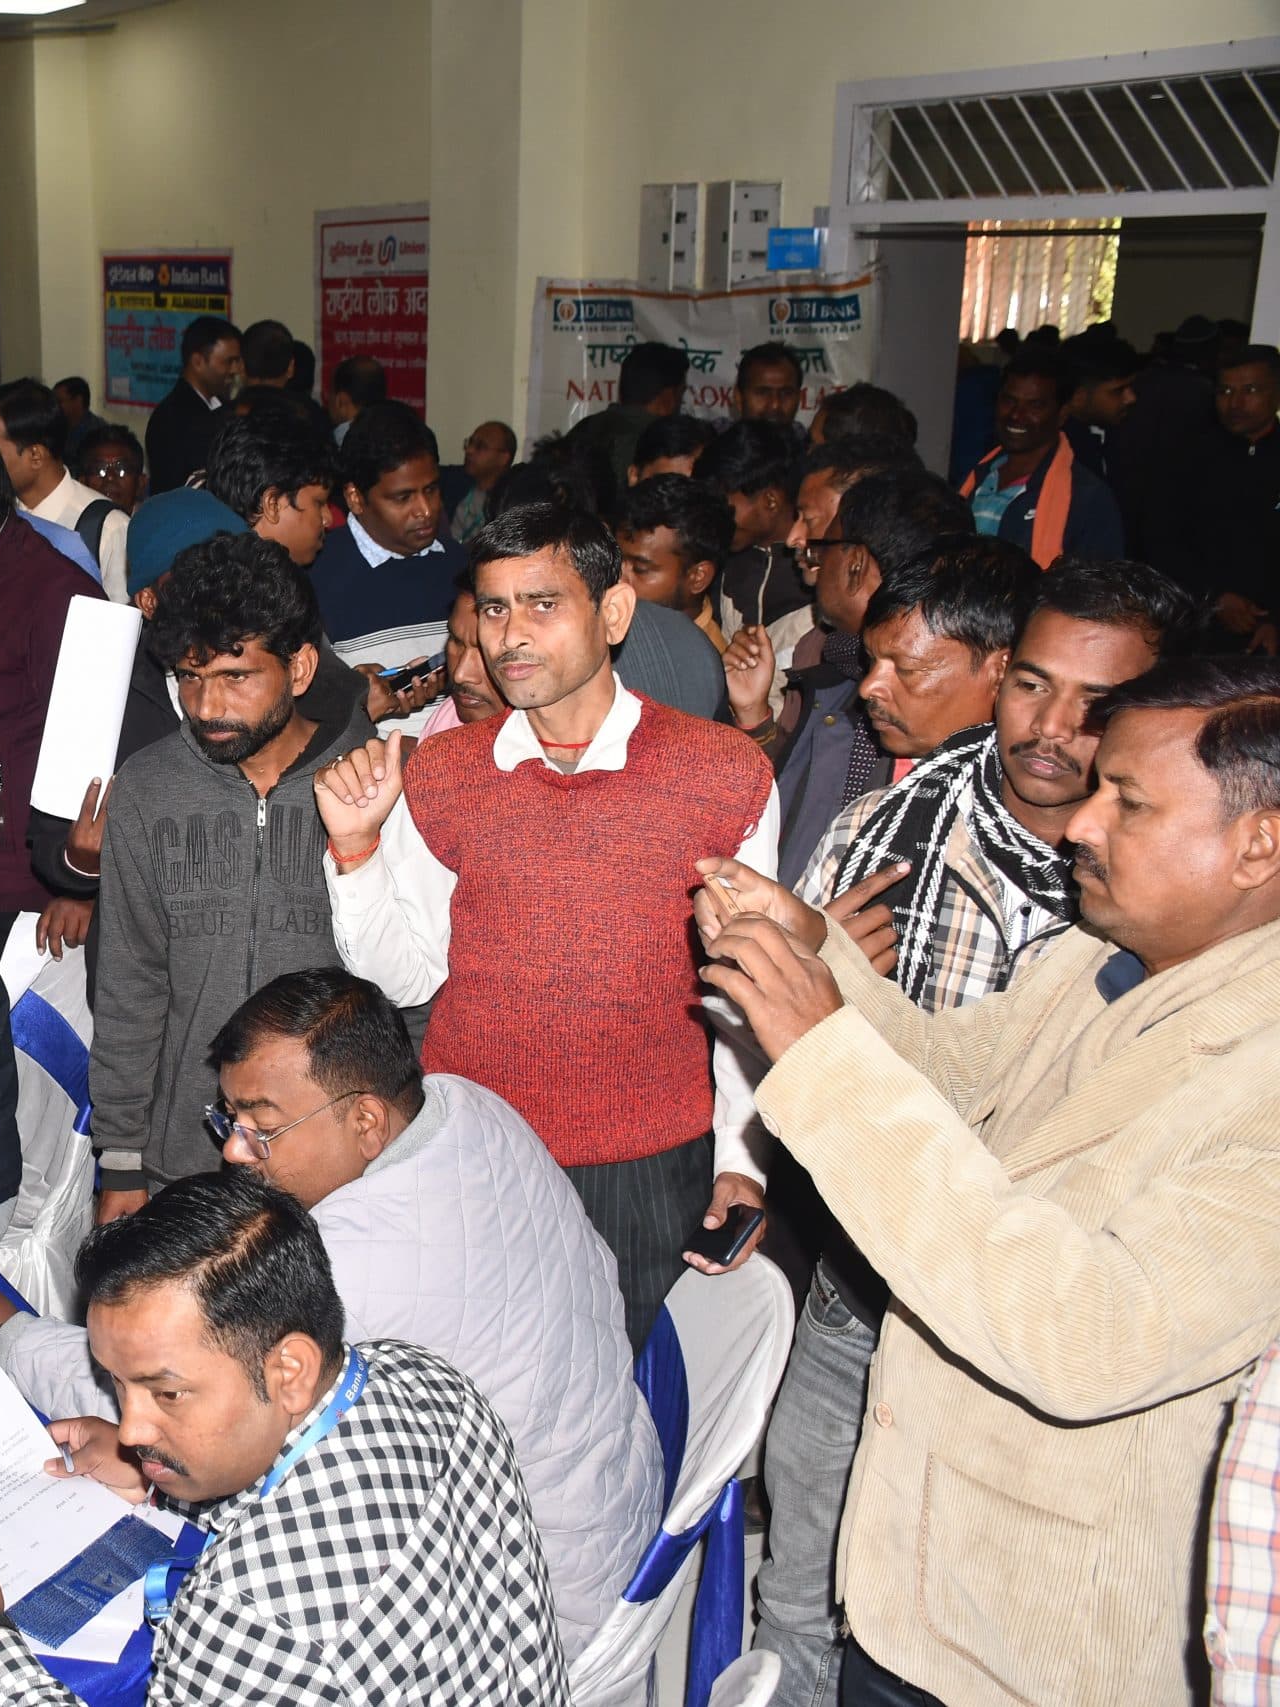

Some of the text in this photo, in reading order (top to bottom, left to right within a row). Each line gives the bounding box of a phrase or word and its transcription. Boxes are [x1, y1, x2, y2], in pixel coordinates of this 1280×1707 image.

[171, 266, 225, 286] Indian Bank
[325, 279, 364, 322] राष्ट्रीय
[367, 280, 399, 316] लोक
[168, 904, 332, 940] BLUE LABE
[345, 1373, 363, 1402] Bank
